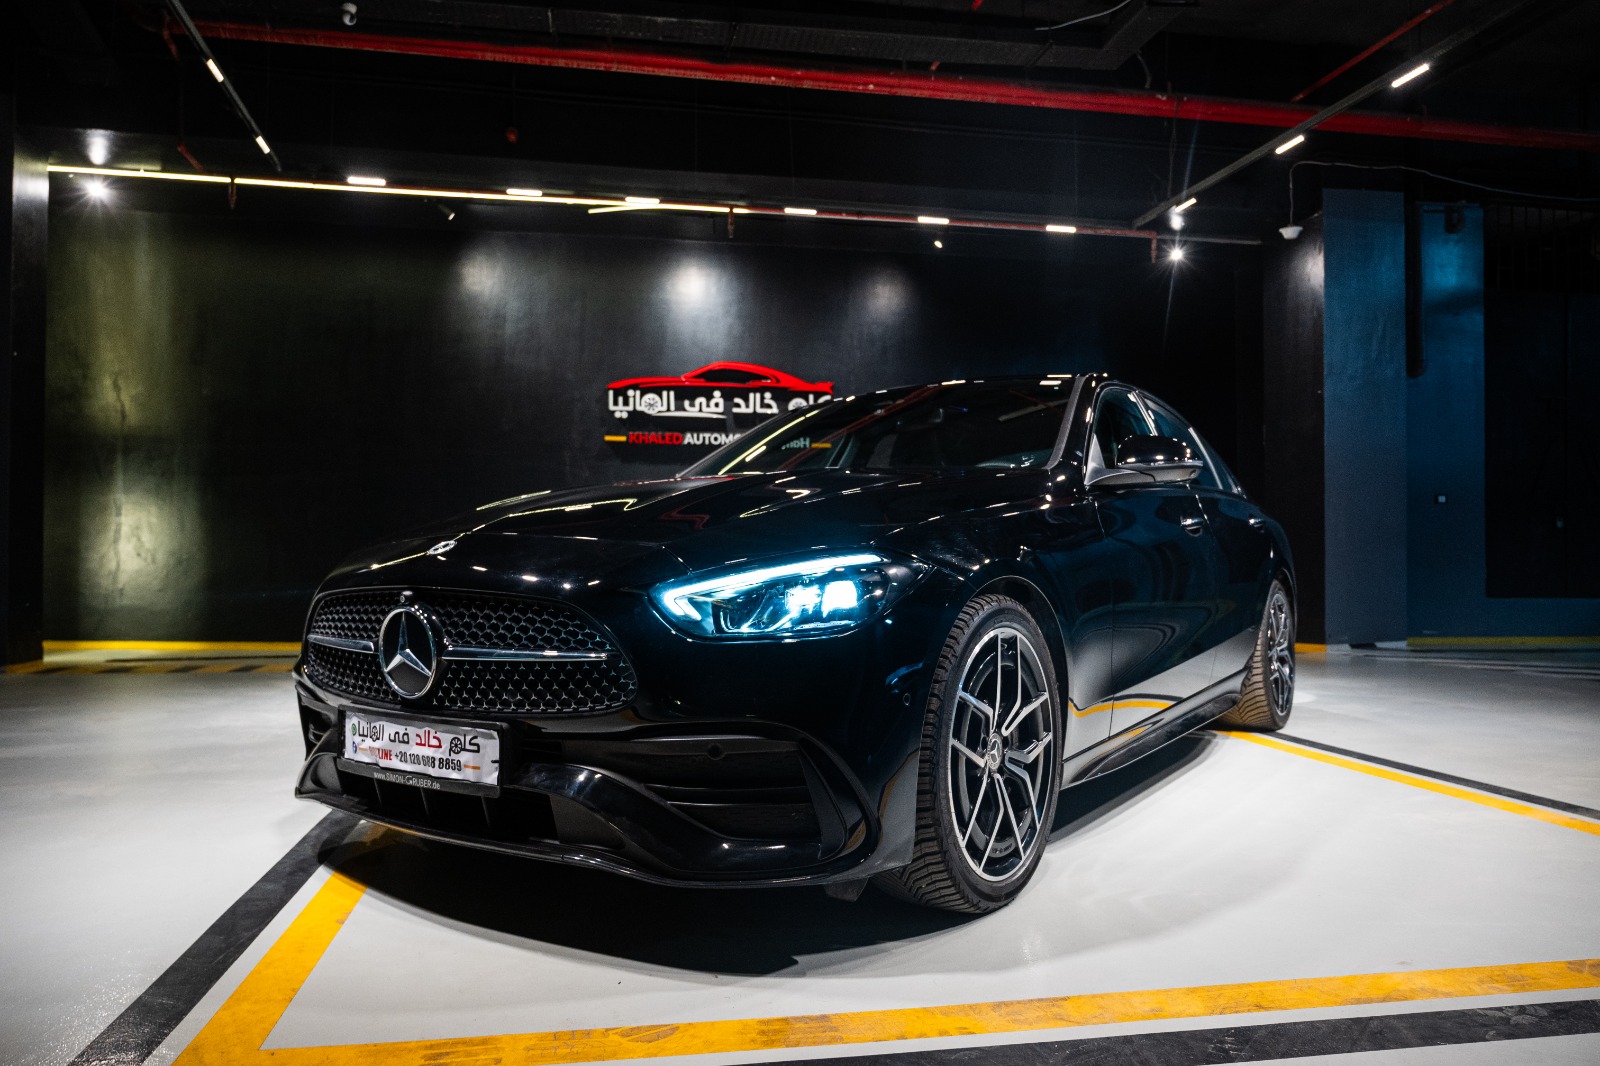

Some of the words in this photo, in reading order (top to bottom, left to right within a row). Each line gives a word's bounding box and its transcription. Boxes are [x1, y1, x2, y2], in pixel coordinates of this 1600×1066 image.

[731, 391, 779, 414] خالد
[628, 432, 683, 446] KHALED
[415, 729, 443, 749] خالد
[369, 746, 393, 761] LINE
[394, 751, 408, 764] +20
[438, 757, 462, 772] 8859
